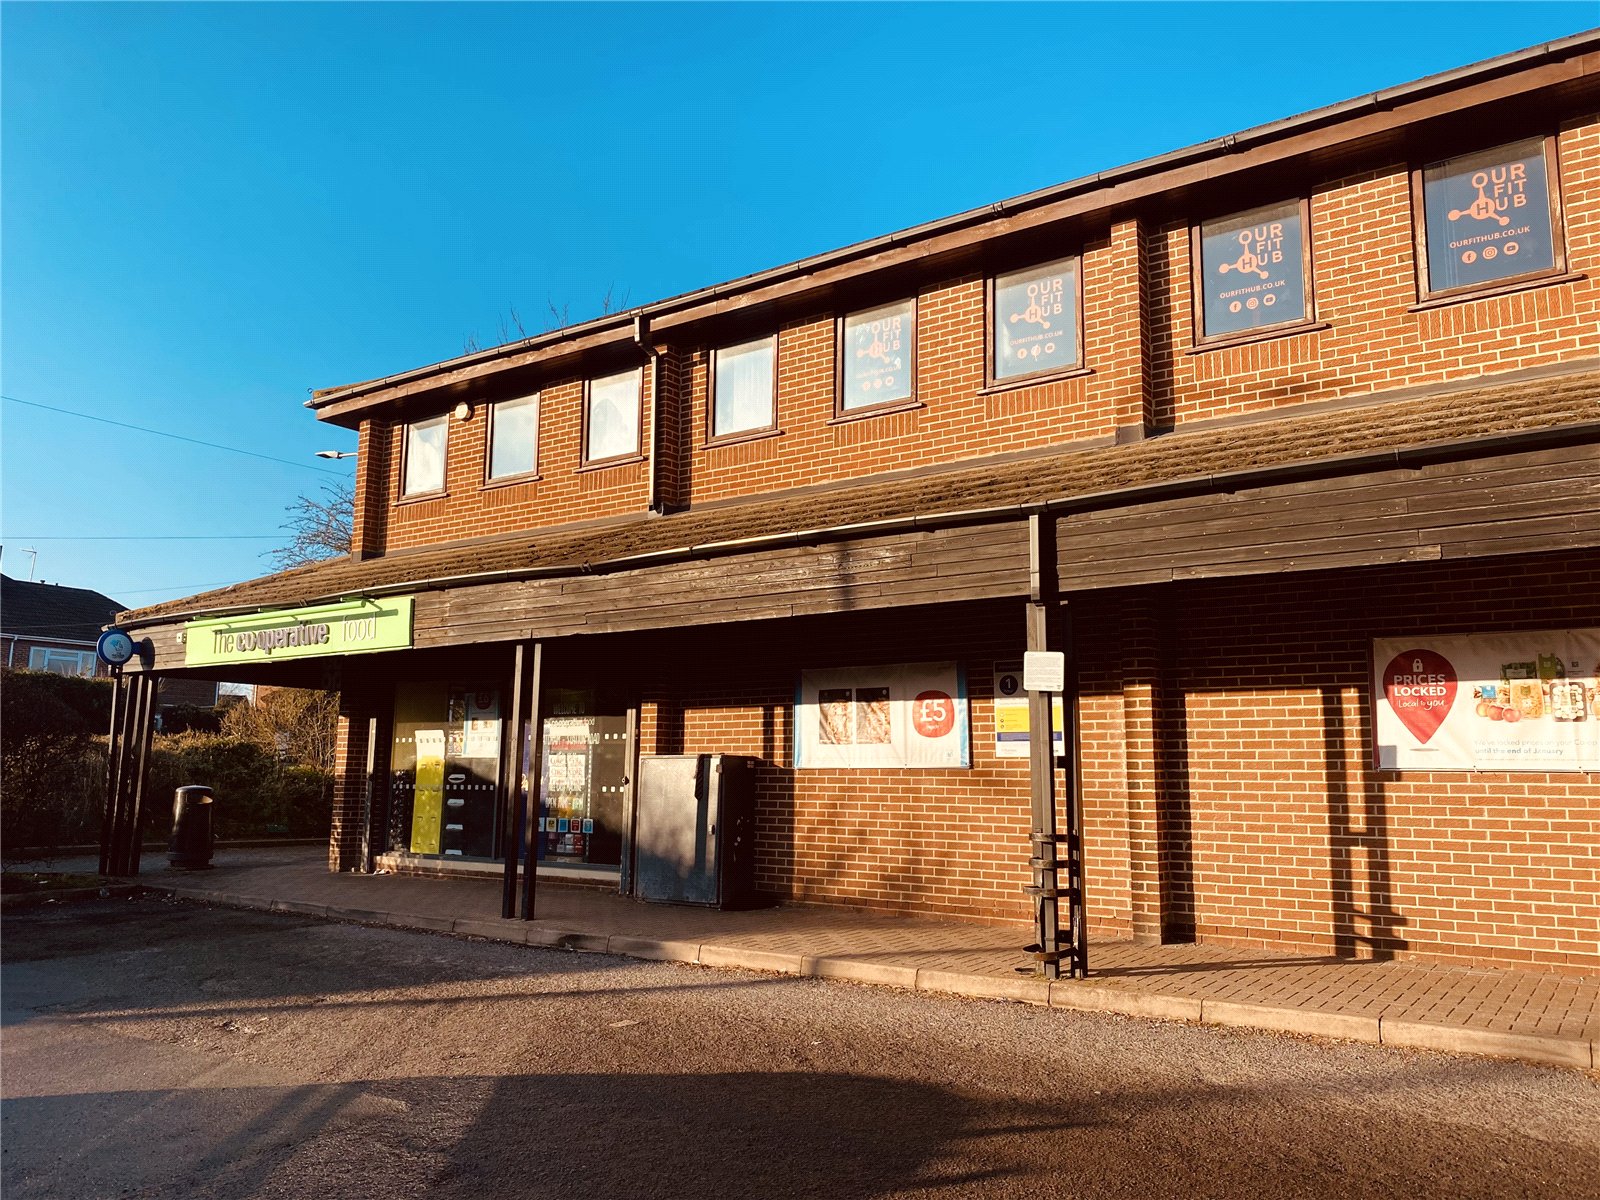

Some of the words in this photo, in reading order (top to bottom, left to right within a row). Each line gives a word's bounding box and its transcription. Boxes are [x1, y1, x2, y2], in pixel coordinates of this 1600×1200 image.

[1471, 163, 1527, 188] OUR
[1493, 178, 1528, 198] FIT
[1475, 193, 1527, 216] HUB
[1238, 223, 1284, 245] OUR
[1449, 225, 1531, 249] OURFITHUB.CO.UK
[1256, 237, 1284, 254] FIT
[1242, 250, 1283, 270] HUB
[1027, 278, 1063, 297] OUR
[1219, 280, 1286, 299] OURFITHUB.CO.UK
[1041, 291, 1063, 306] FIT
[871, 317, 901, 334] OUR
[883, 329, 901, 342] FIT
[213, 629, 235, 654] The
[342, 611, 376, 643] food
[1005, 677, 1011, 689] 1
[1393, 674, 1446, 686] PRICES
[1394, 686, 1447, 697] LOCKED
[920, 699, 947, 722] £5
[1398, 698, 1419, 708] Local
[1424, 699, 1445, 711] you
[1533, 747, 1563, 755] January
